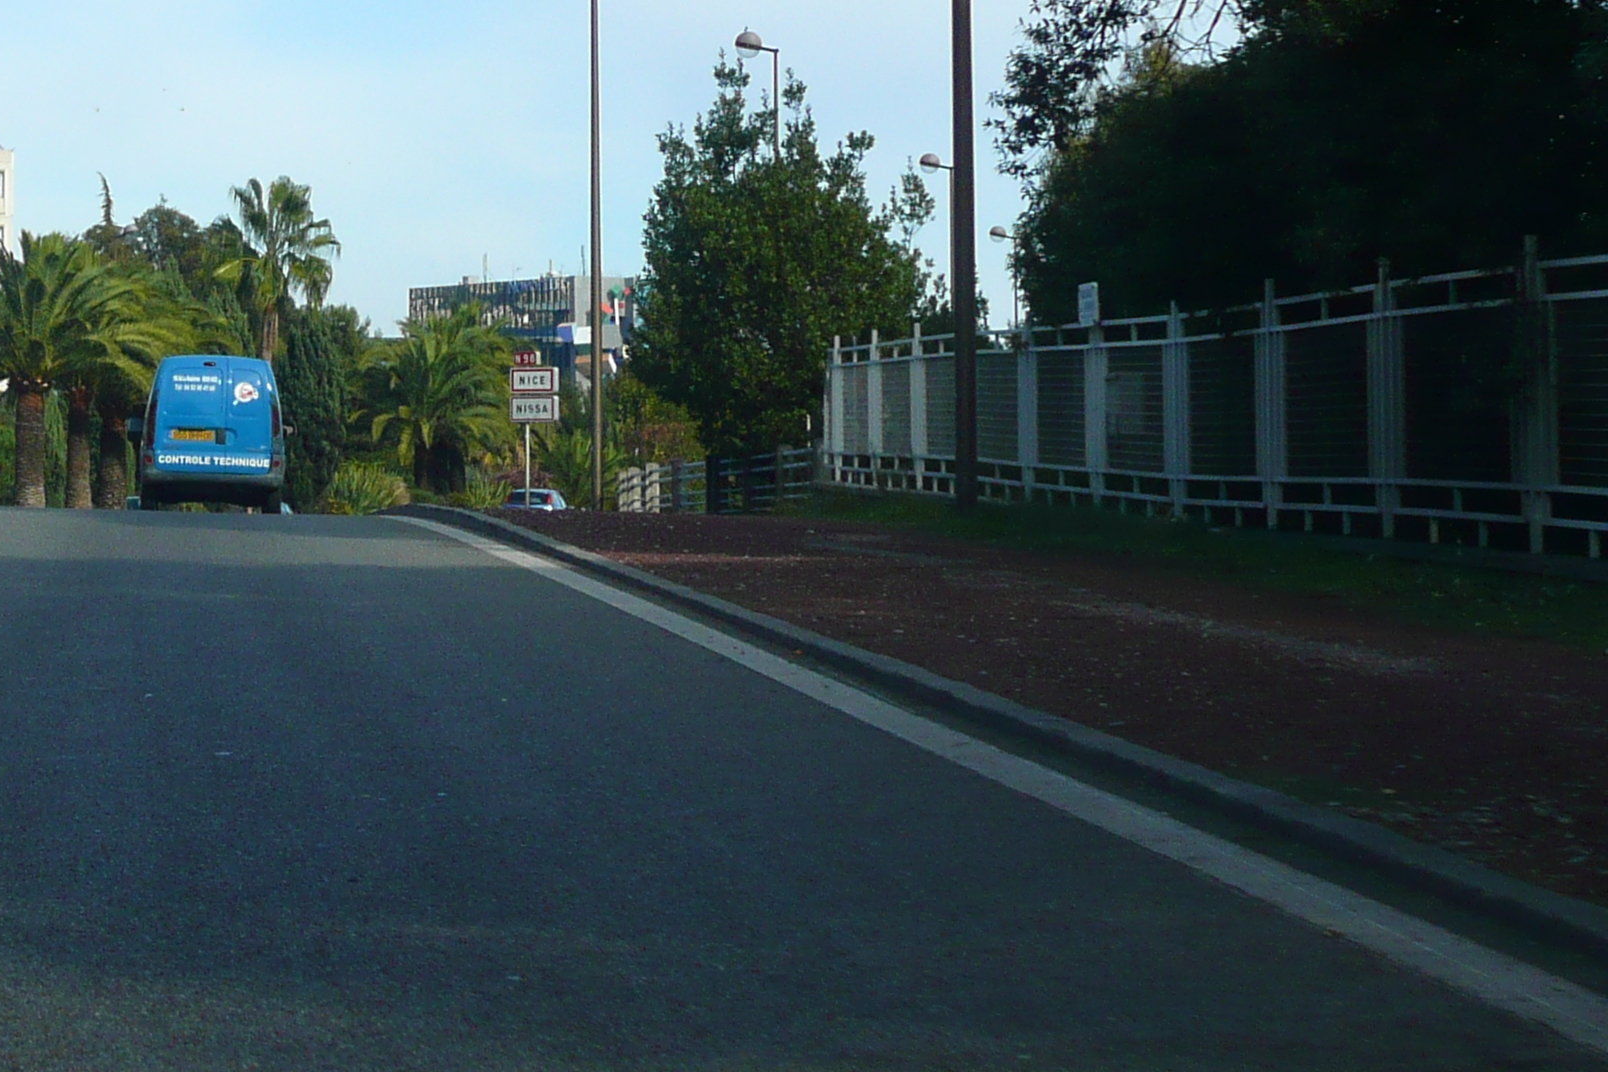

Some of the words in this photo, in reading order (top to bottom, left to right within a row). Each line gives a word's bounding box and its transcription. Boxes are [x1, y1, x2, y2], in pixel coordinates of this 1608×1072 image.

[519, 375, 546, 386] NICE
[516, 404, 548, 414] NISSA
[158, 455, 211, 465] CONTROLE
[213, 456, 270, 467] TECHNIQUE
